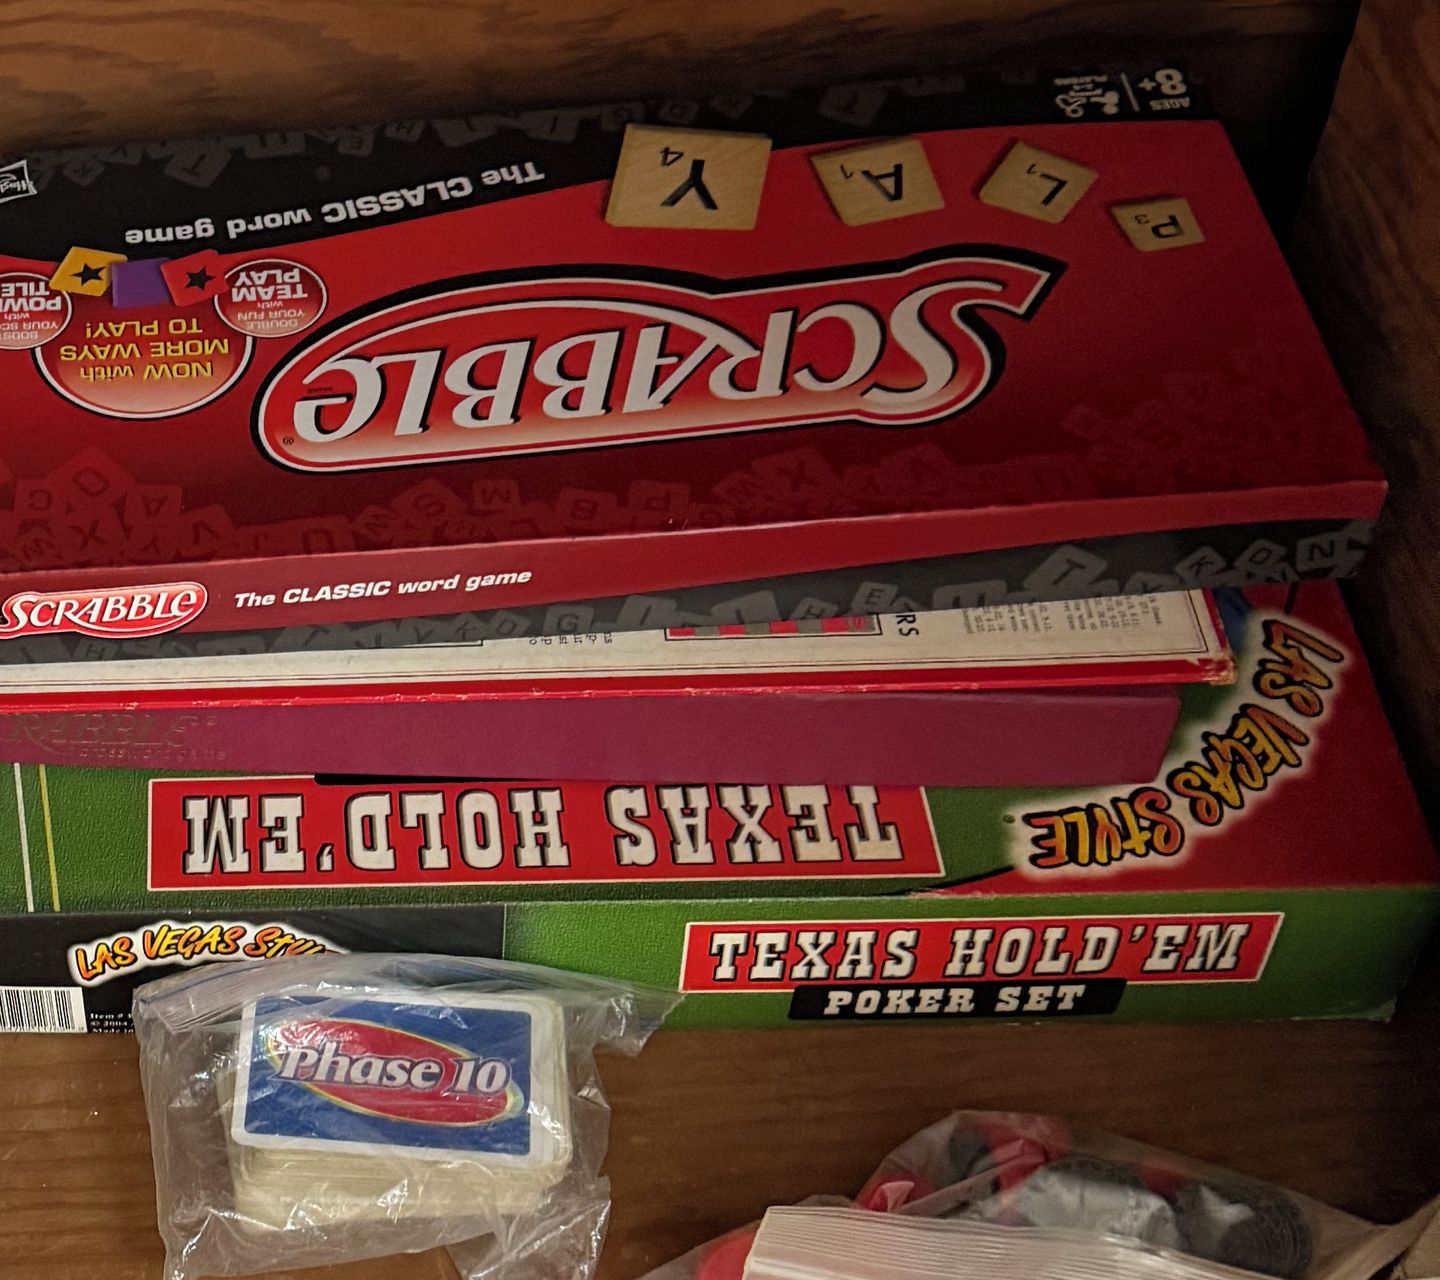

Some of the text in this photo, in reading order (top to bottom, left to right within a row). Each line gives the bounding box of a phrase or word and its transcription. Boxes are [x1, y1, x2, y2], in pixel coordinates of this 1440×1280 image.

[125, 160, 545, 246] The CLASSIC word game
[231, 285, 308, 303] TEAM
[234, 268, 300, 286] PLAY
[85, 318, 204, 338] TO PLAY!
[59, 338, 230, 361] MORE WAYS
[79, 361, 213, 383] NOW with
[235, 567, 532, 608] The CLASSIC word game
[182, 785, 903, 875] TEXAS HOLD'EM
[74, 936, 138, 981] LAS
[142, 924, 248, 960] VEGAS
[708, 921, 1250, 982] TEXAS HOLD'EM
[822, 983, 1086, 1017] POKER SET
[276, 1041, 510, 1094] Phase 10
